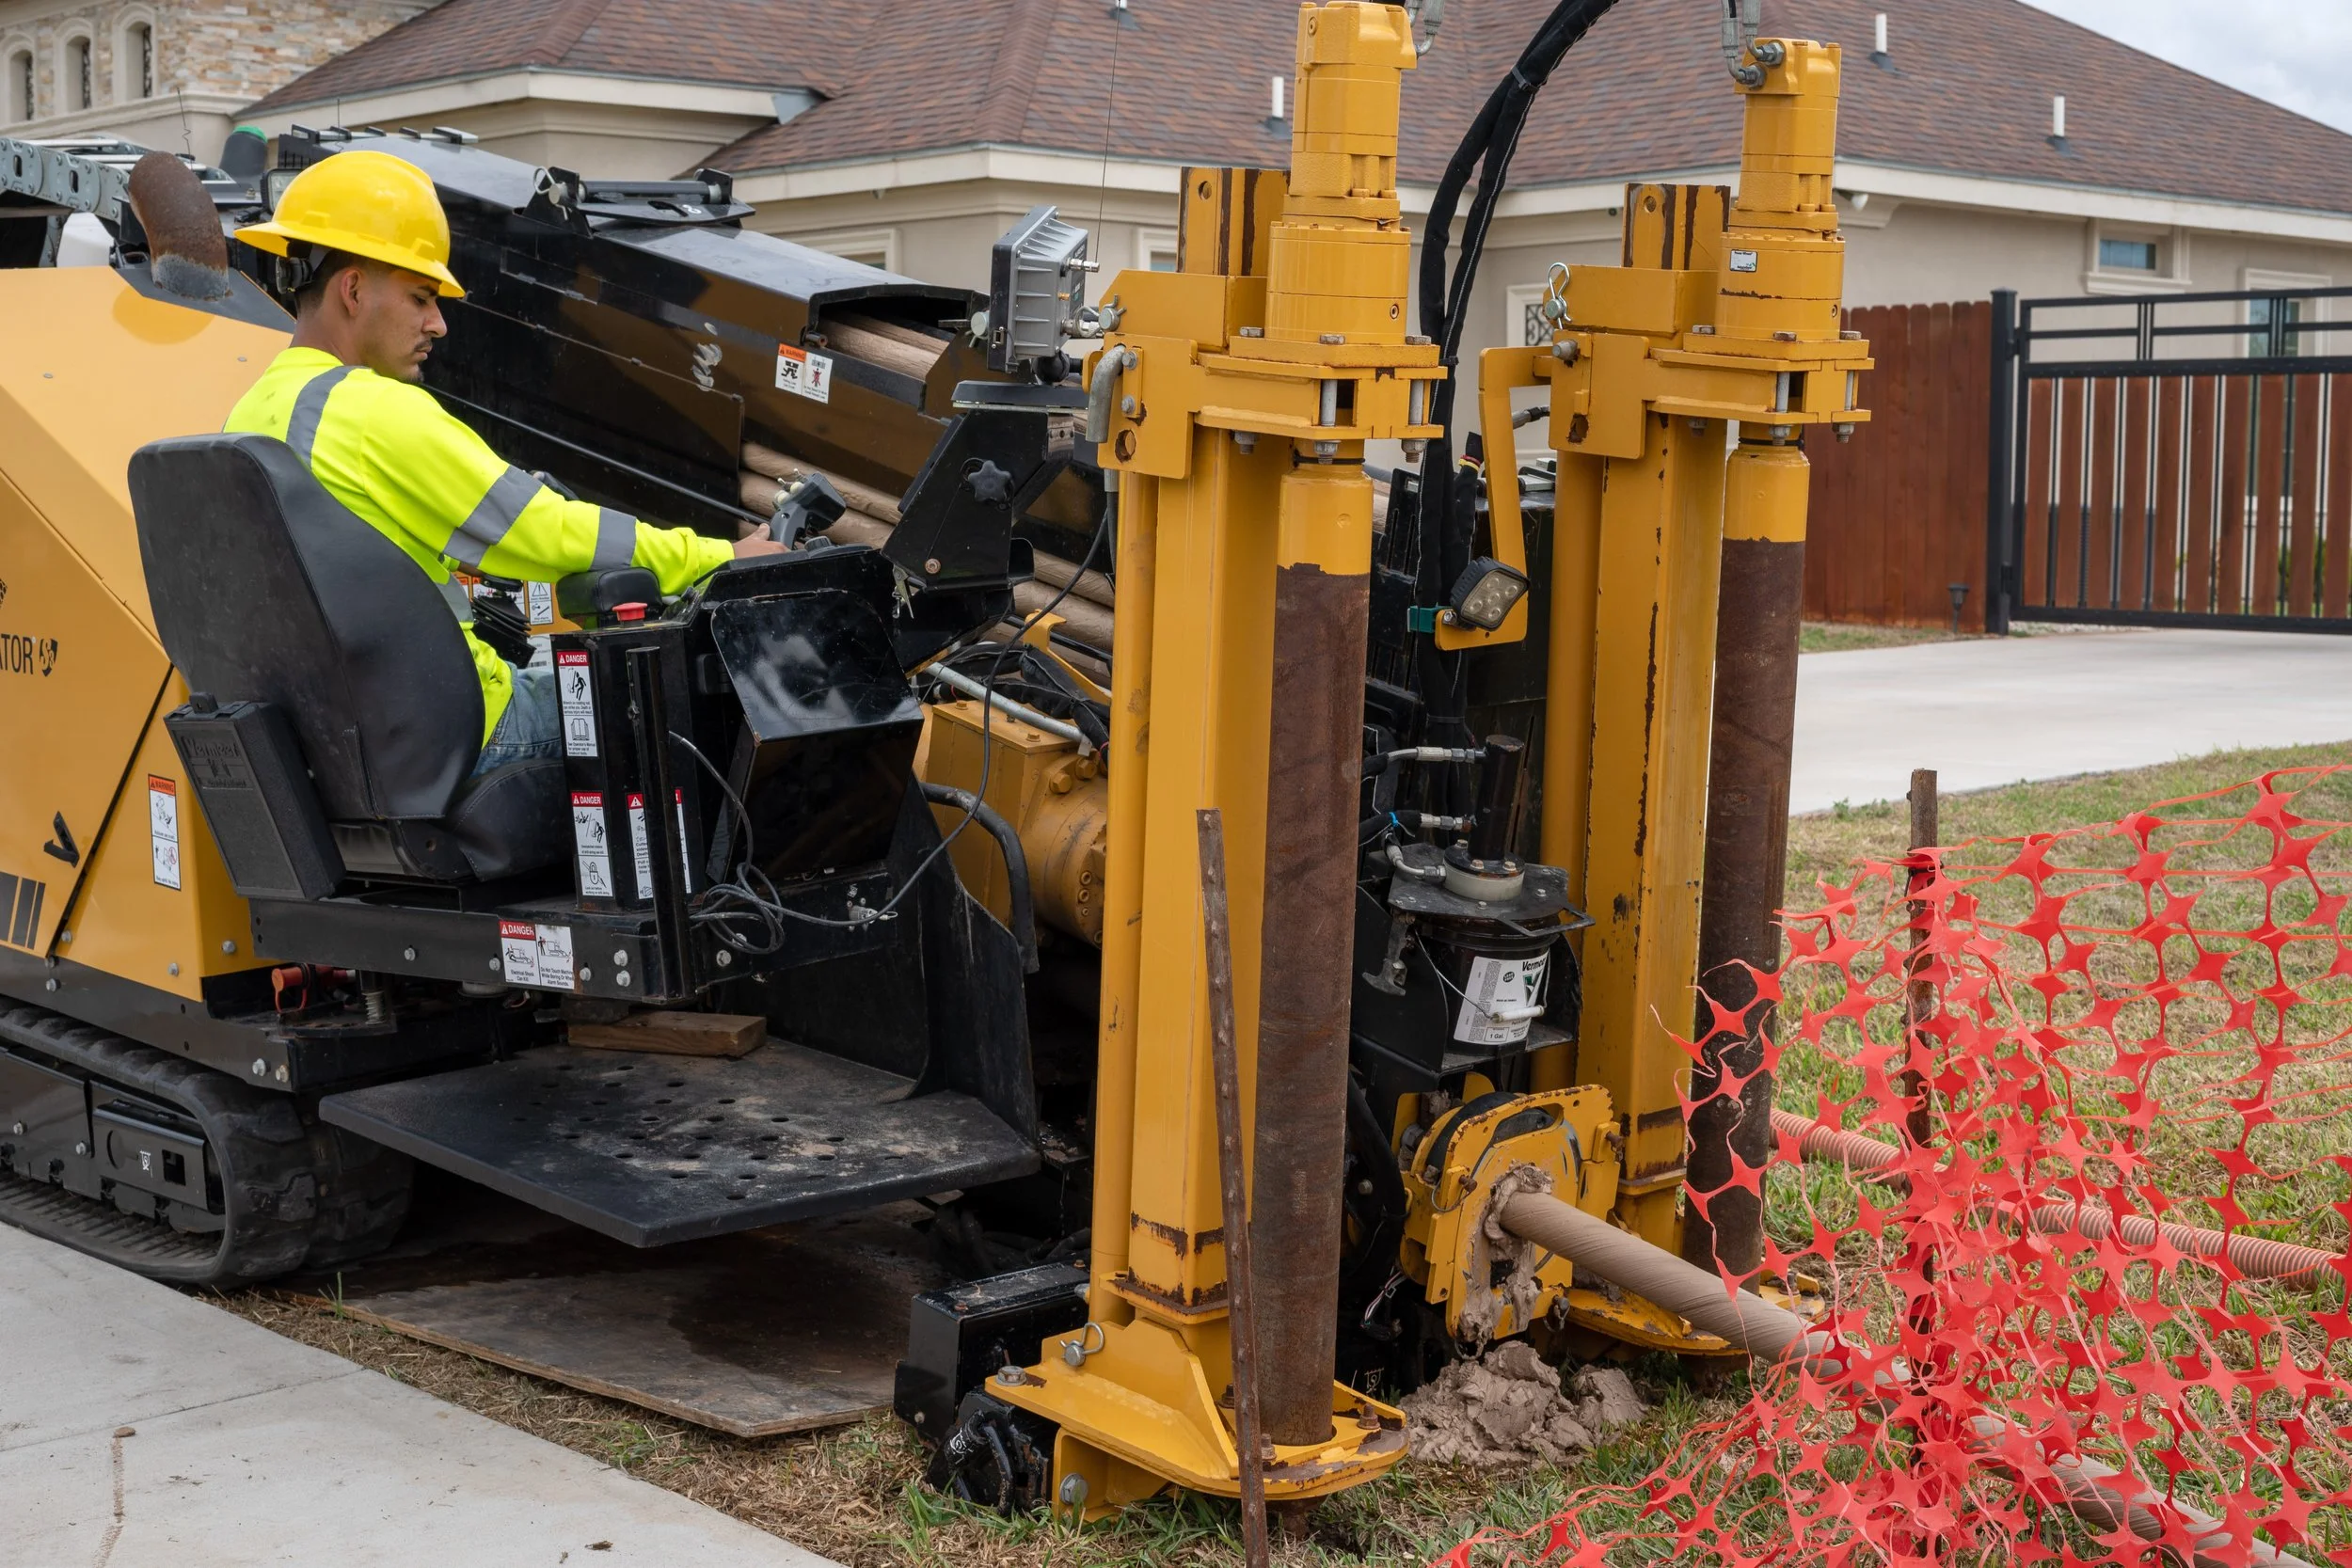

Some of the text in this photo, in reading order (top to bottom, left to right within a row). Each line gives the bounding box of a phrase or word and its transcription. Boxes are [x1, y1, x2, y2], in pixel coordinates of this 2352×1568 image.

[0, 633, 34, 675] TOR
[565, 654, 588, 663] DANGER
[155, 781, 174, 793] WARNING
[580, 796, 601, 804] DANGER
[508, 925, 534, 936] DANGER
